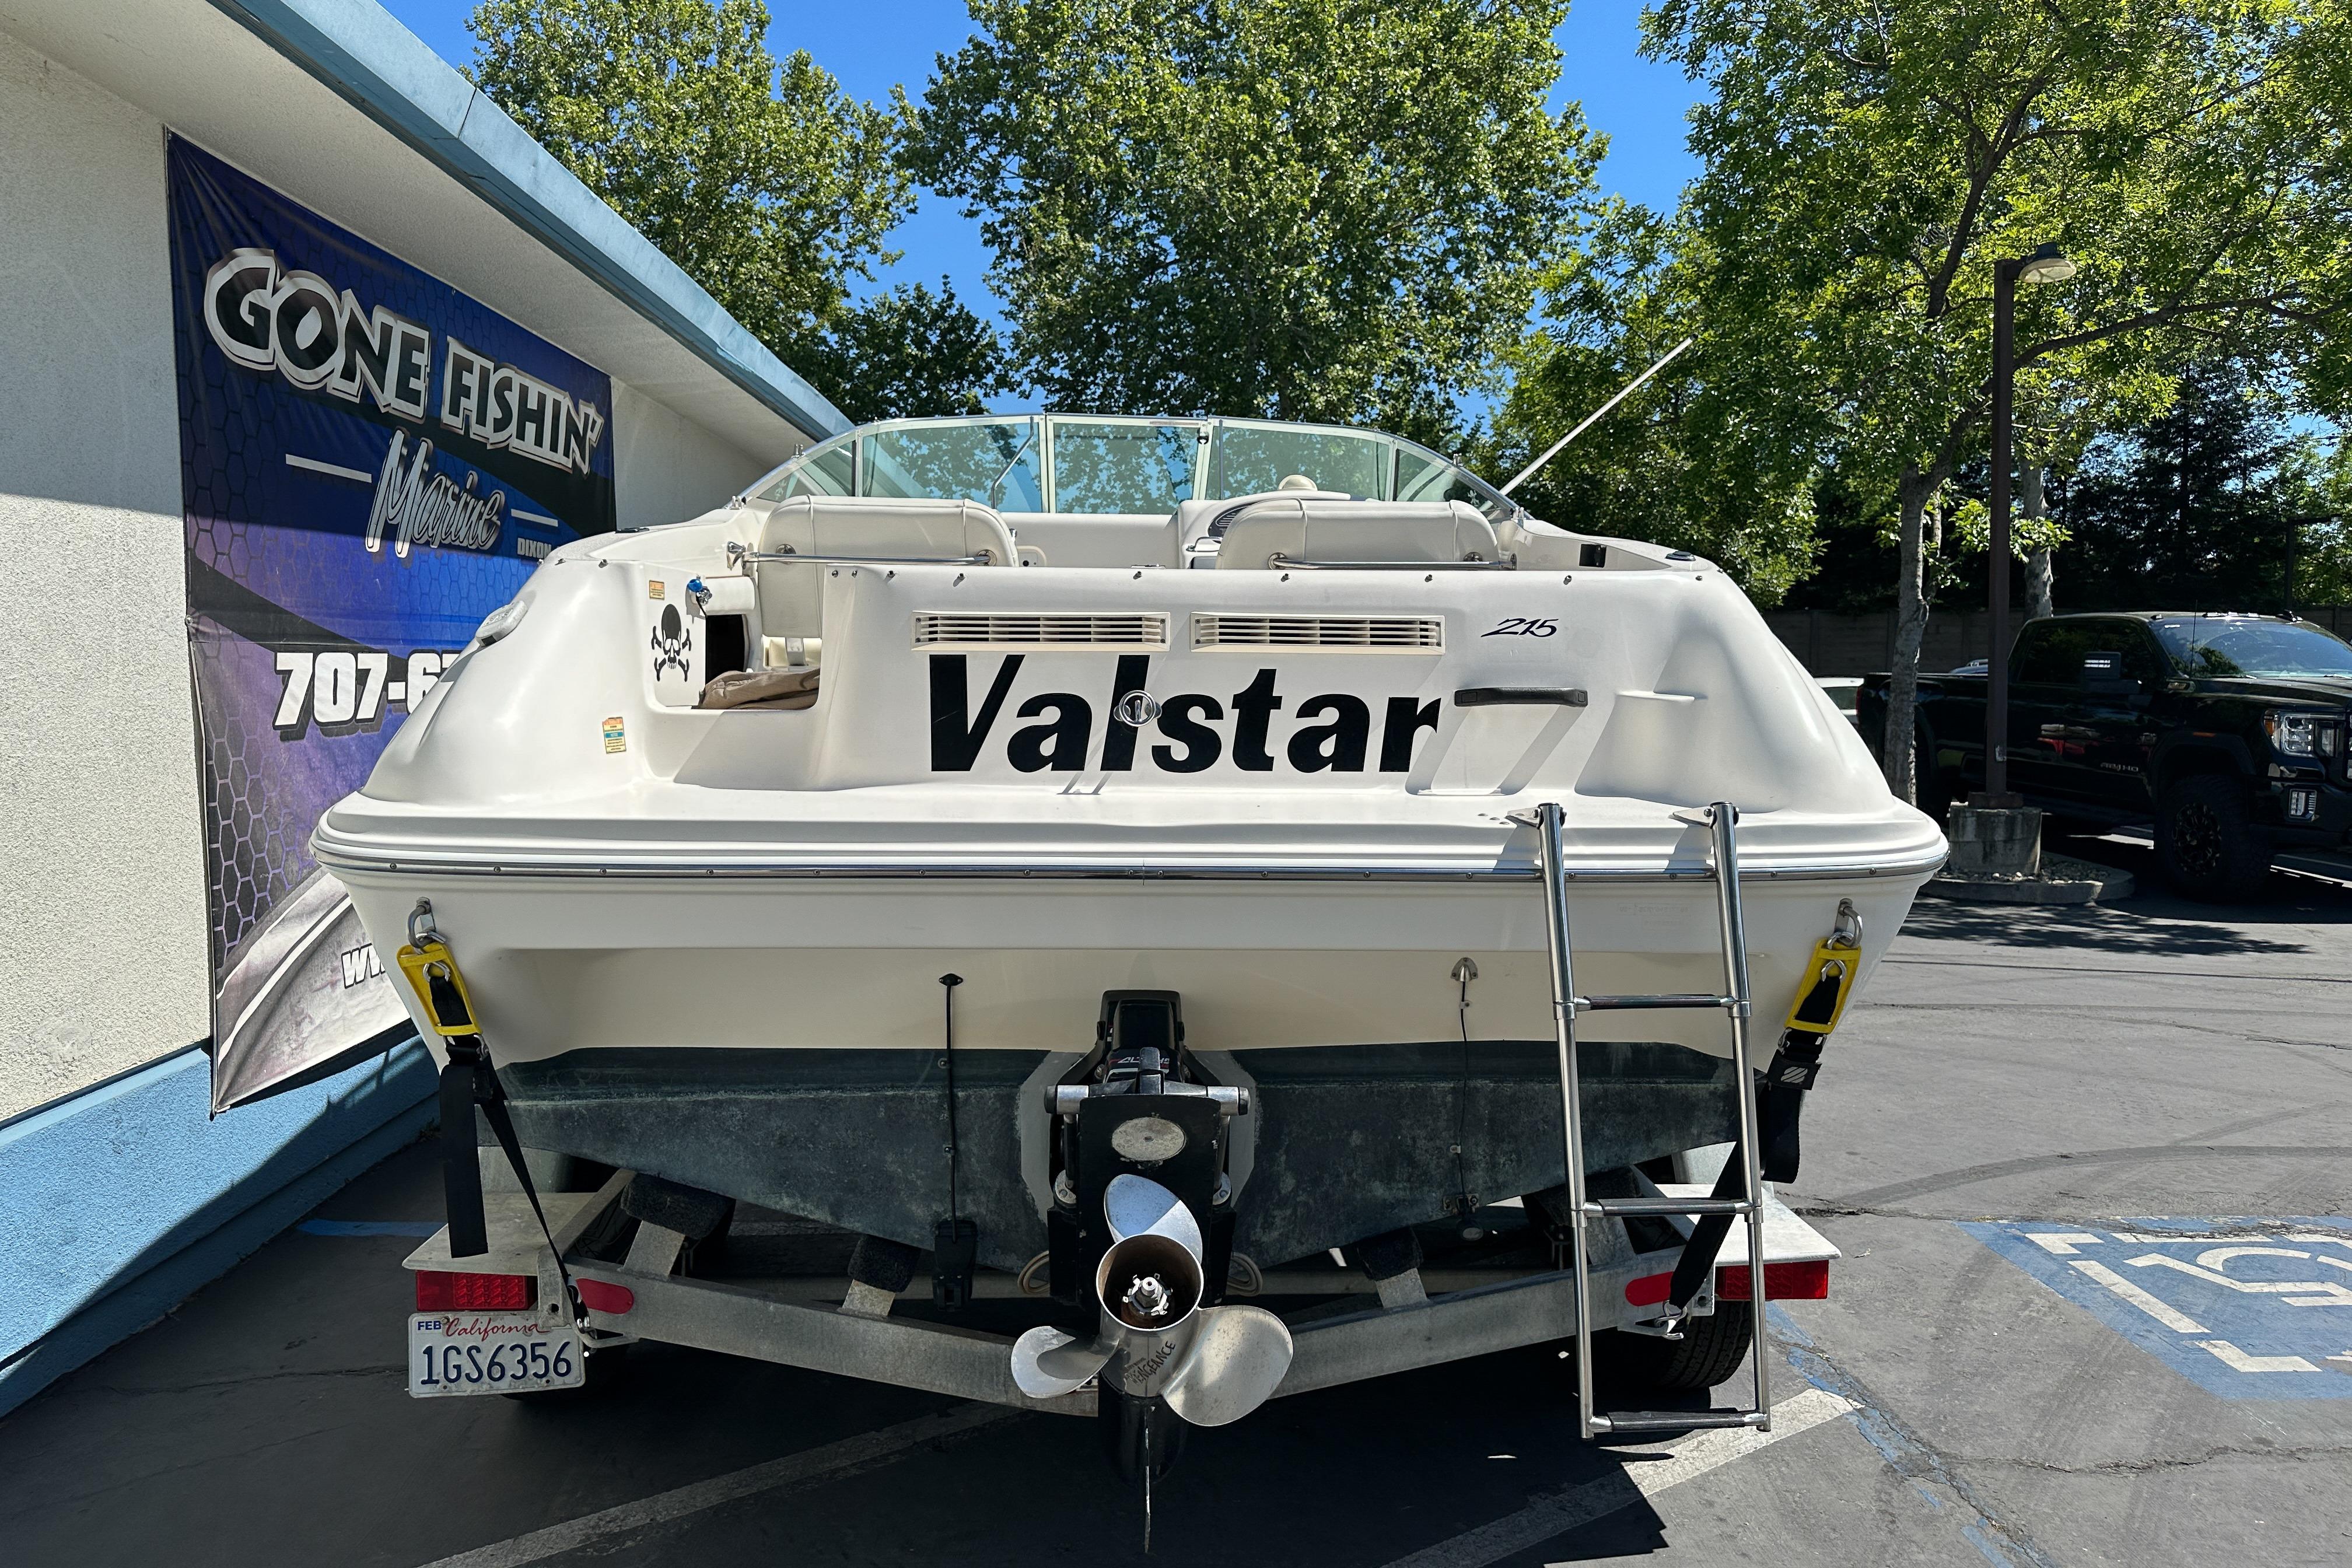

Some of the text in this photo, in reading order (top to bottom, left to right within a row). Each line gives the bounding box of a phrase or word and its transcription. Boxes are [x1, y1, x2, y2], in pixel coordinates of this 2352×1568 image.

[205, 249, 604, 478] GONE FISHIN'
[366, 428, 504, 558] Marine
[1480, 618, 1559, 637] 215
[929, 654, 1441, 774] Valstar
[417, 1321, 442, 1331] FEB
[445, 1317, 550, 1342] California
[420, 1341, 572, 1385] 1GS6356
[1127, 1340, 1176, 1385] VENGEANCE
